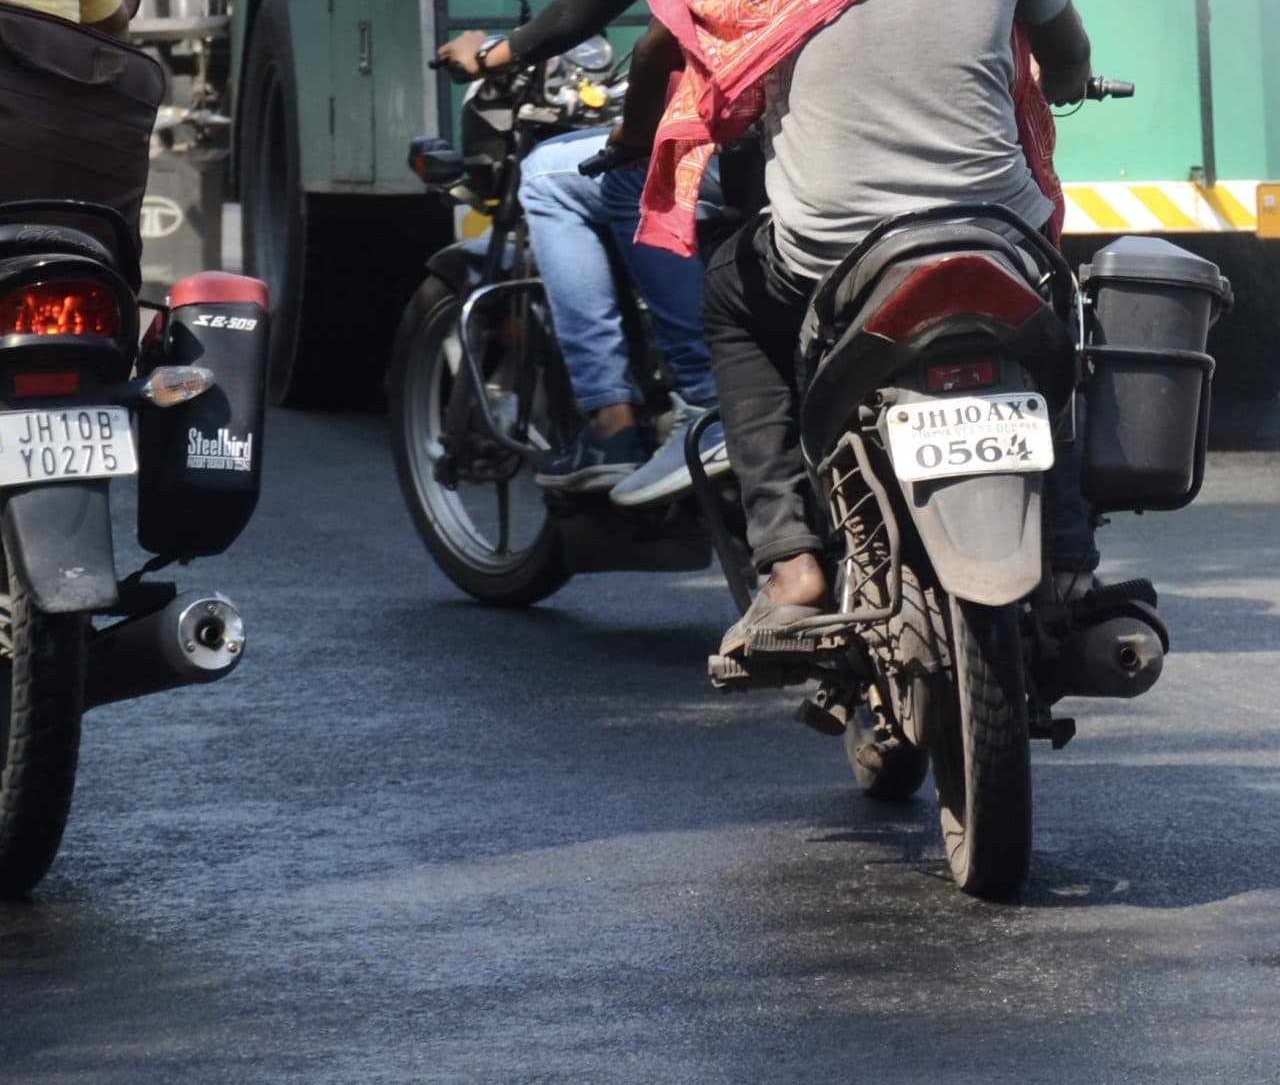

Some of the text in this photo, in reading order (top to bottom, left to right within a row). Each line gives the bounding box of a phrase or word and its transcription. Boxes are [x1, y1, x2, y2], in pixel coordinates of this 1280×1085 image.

[187, 427, 252, 460] Steelbird
[916, 434, 1032, 469] 0564
[20, 445, 117, 478] Y0275
